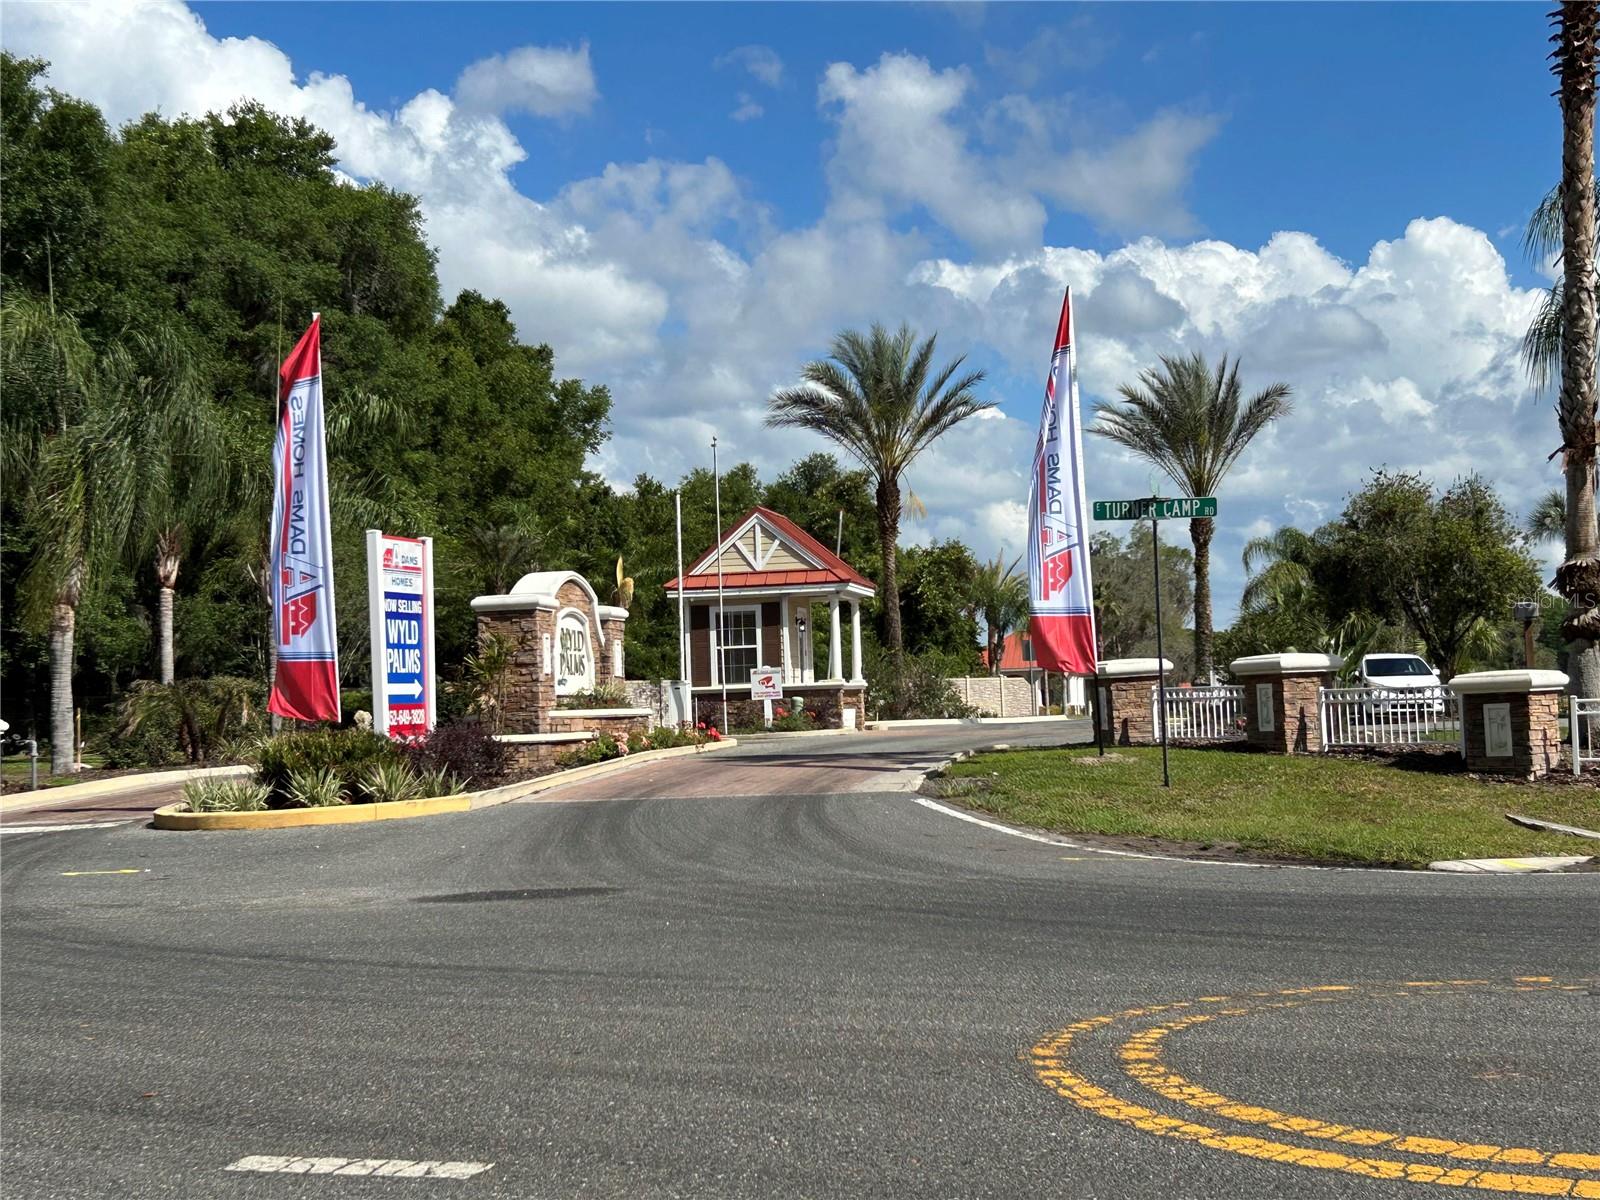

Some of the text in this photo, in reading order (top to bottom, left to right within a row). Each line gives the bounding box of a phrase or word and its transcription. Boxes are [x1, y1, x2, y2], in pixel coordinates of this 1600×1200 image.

[1096, 499, 1214, 519] E TURNER CAMP RD
[391, 576, 413, 587] HOMES
[398, 600, 422, 614] SELLING
[387, 619, 419, 644] WYLD
[387, 649, 420, 673] PALMS
[560, 653, 585, 676] PALMS
